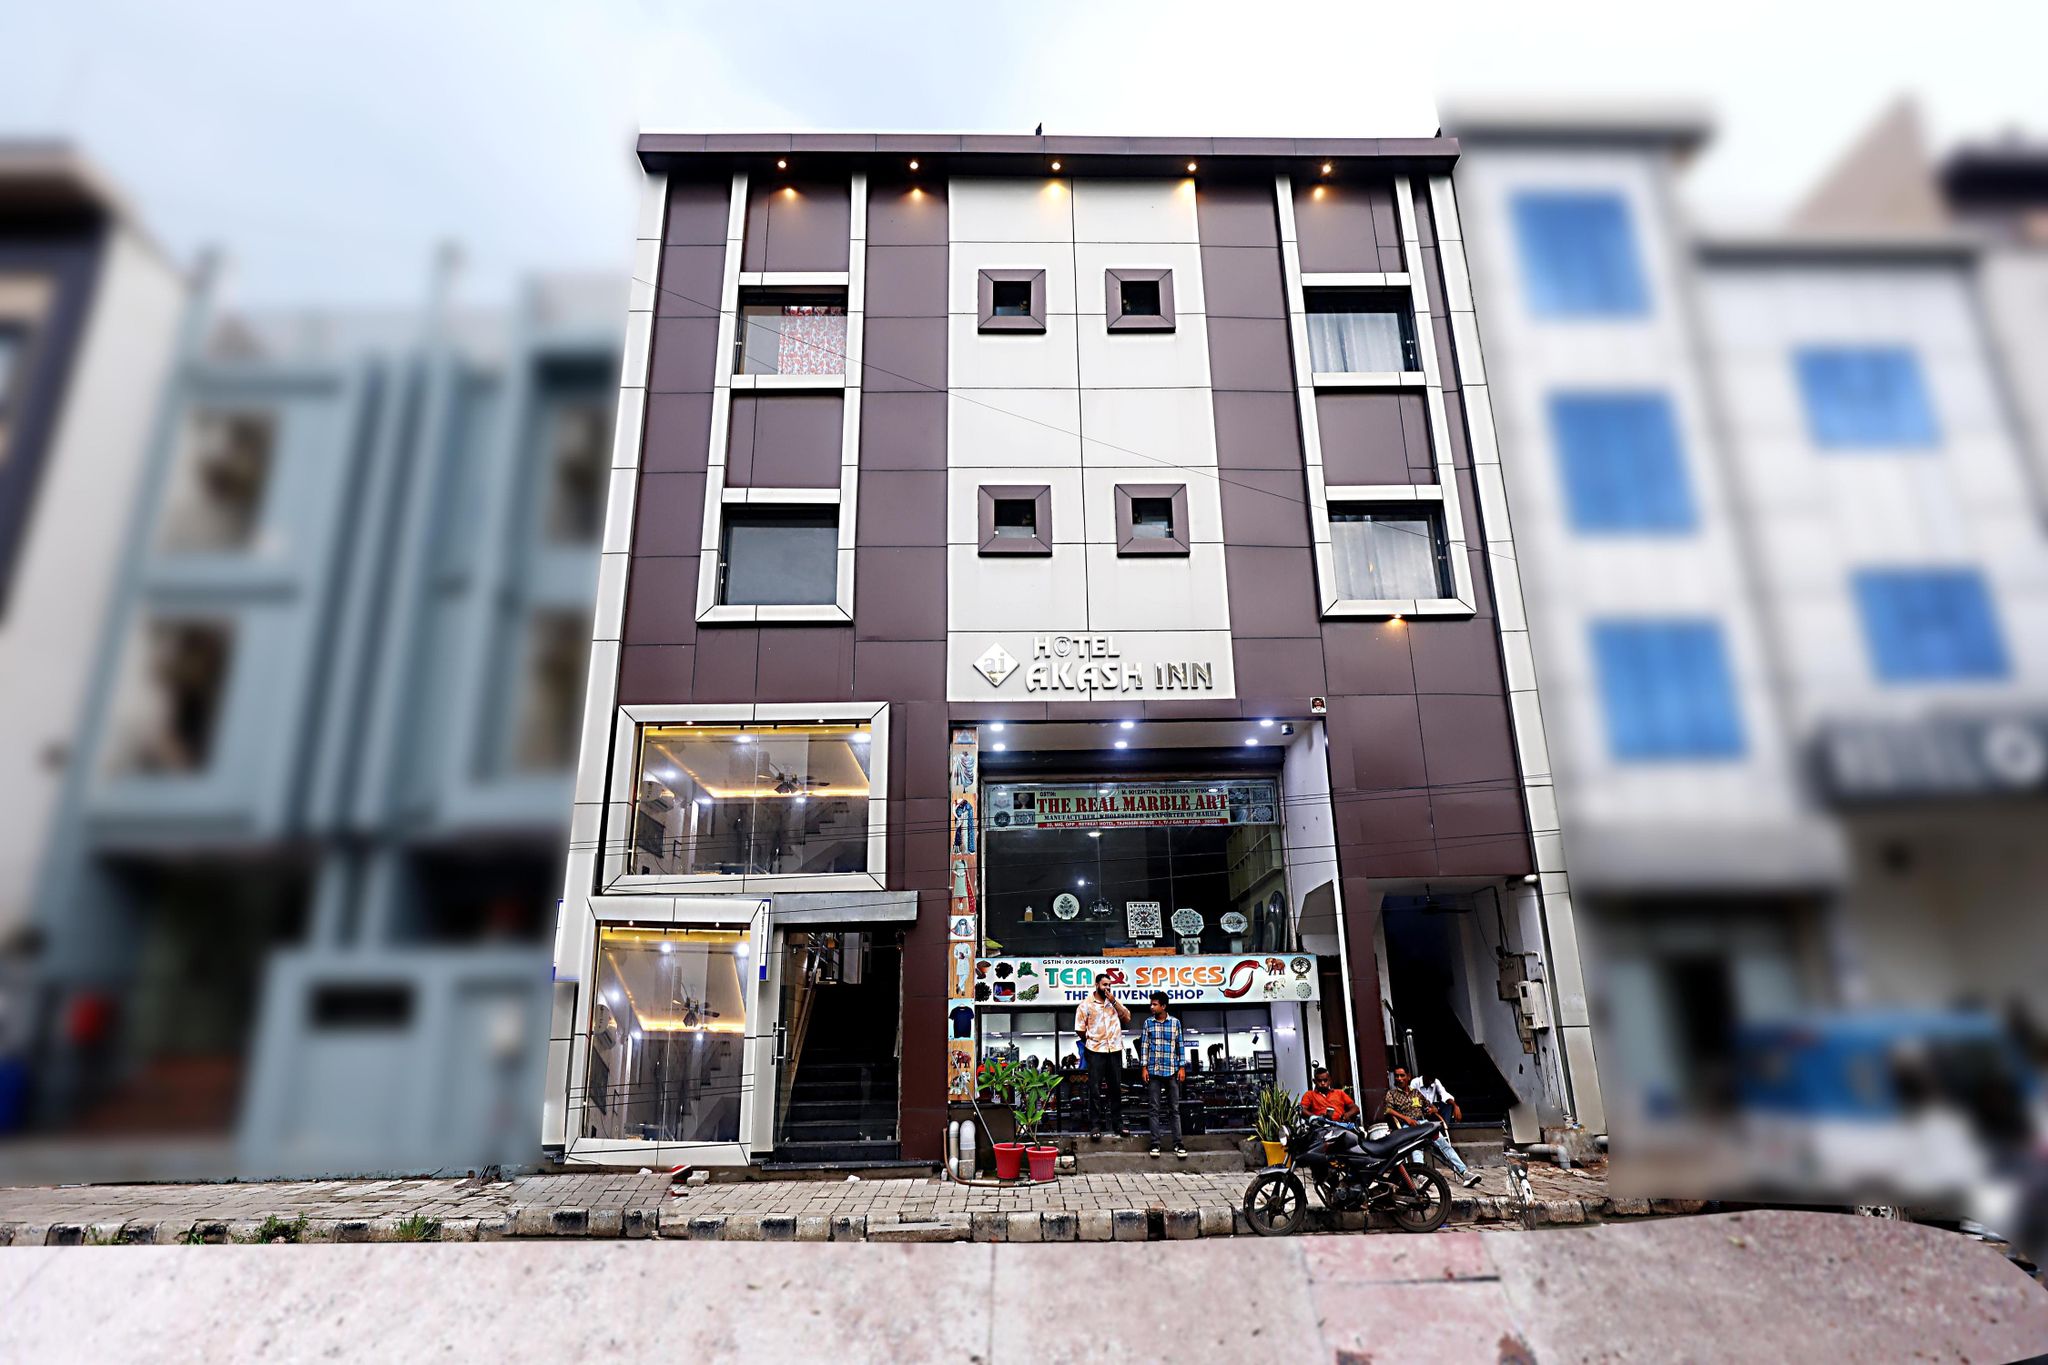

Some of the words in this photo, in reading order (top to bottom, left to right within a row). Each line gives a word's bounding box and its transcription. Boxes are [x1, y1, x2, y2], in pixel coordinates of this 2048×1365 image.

[1033, 636, 1121, 660] HOTEL
[1026, 662, 1144, 693] AKASH
[1155, 661, 1213, 689] INN
[1037, 798, 1071, 813] THE
[1076, 796, 1119, 813] REAL
[1122, 795, 1190, 812] MARBLE
[1195, 793, 1228, 810] ART
[1045, 967, 1094, 987] TEA
[1105, 967, 1129, 986] &
[1135, 966, 1226, 987] SPICES
[1167, 989, 1204, 1000] SHOP
